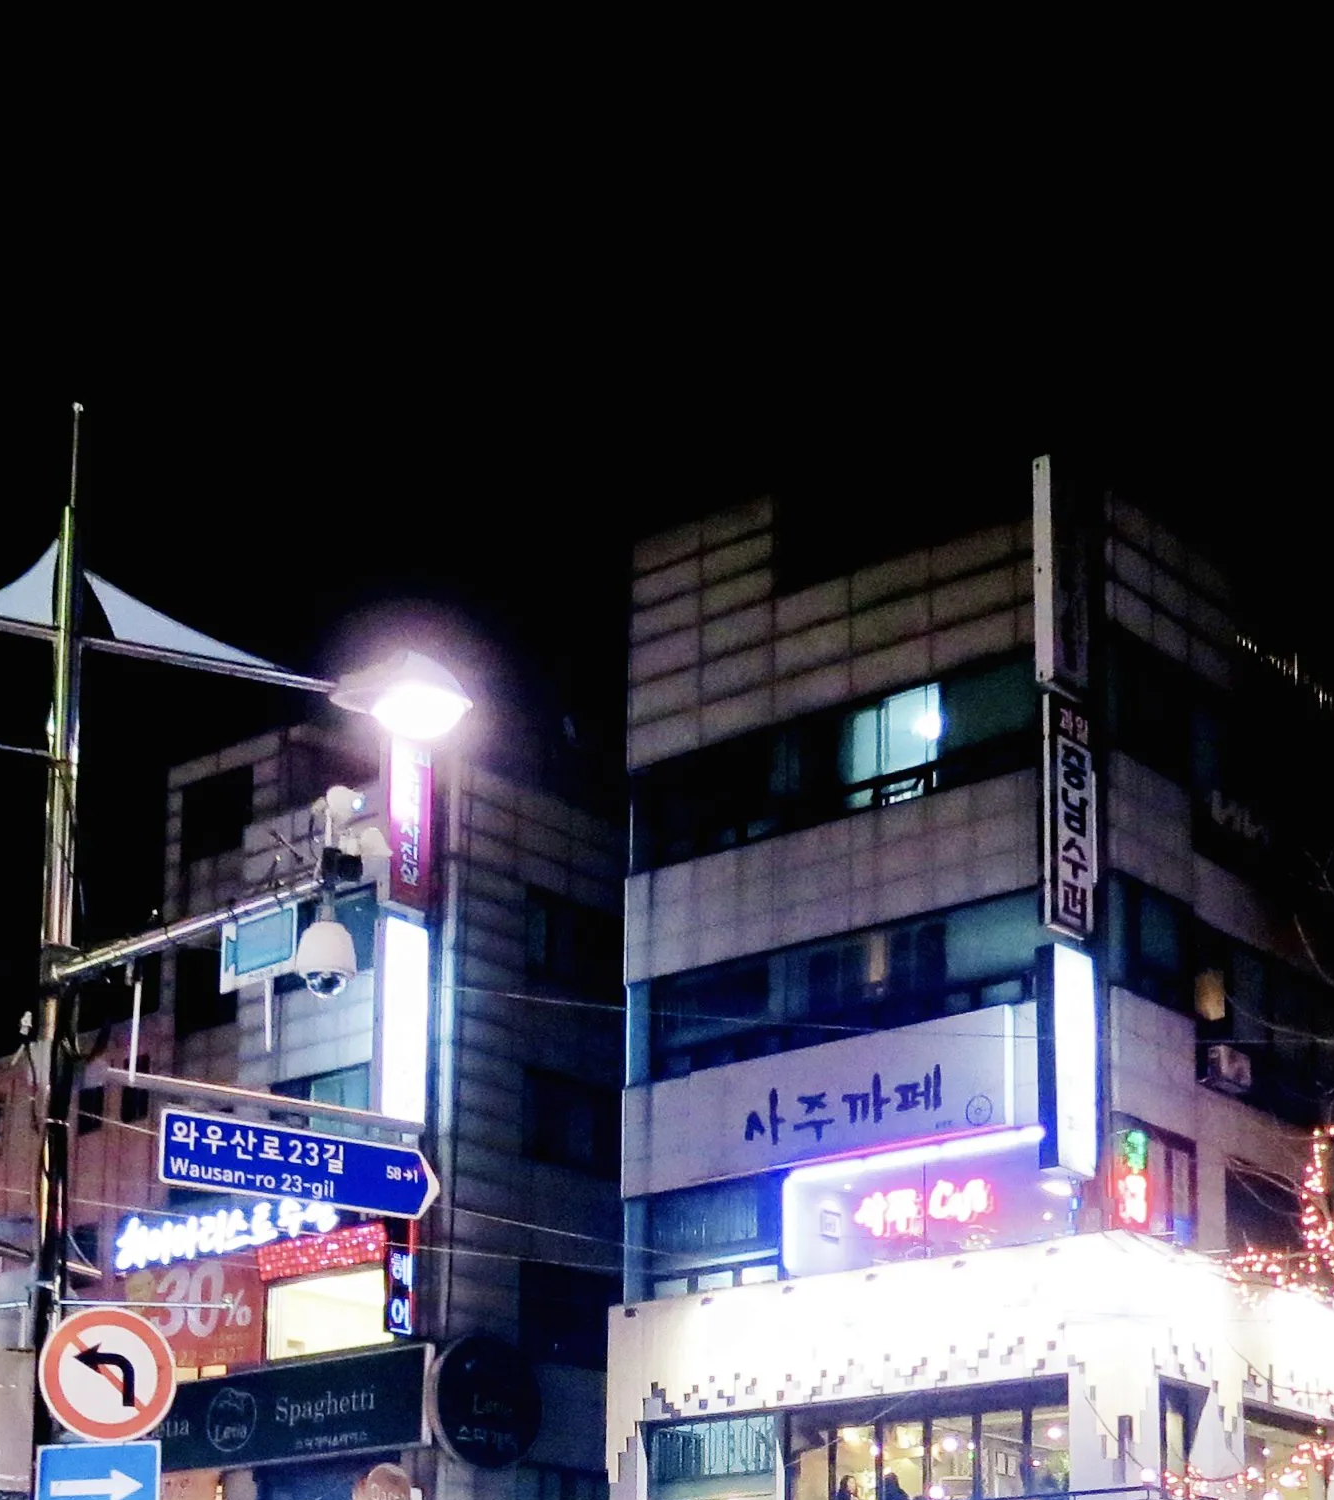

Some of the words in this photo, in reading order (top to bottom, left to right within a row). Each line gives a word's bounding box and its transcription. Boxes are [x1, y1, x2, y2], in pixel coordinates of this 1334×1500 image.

[744, 1064, 942, 1145] 사주까페
[170, 1120, 345, 1174] 와우산로23길
[170, 1156, 276, 1190] Wausan-ro
[281, 1174, 335, 1199] 23-gil
[153, 1261, 253, 1338] 30%
[275, 1384, 376, 1426] Spaghetti
